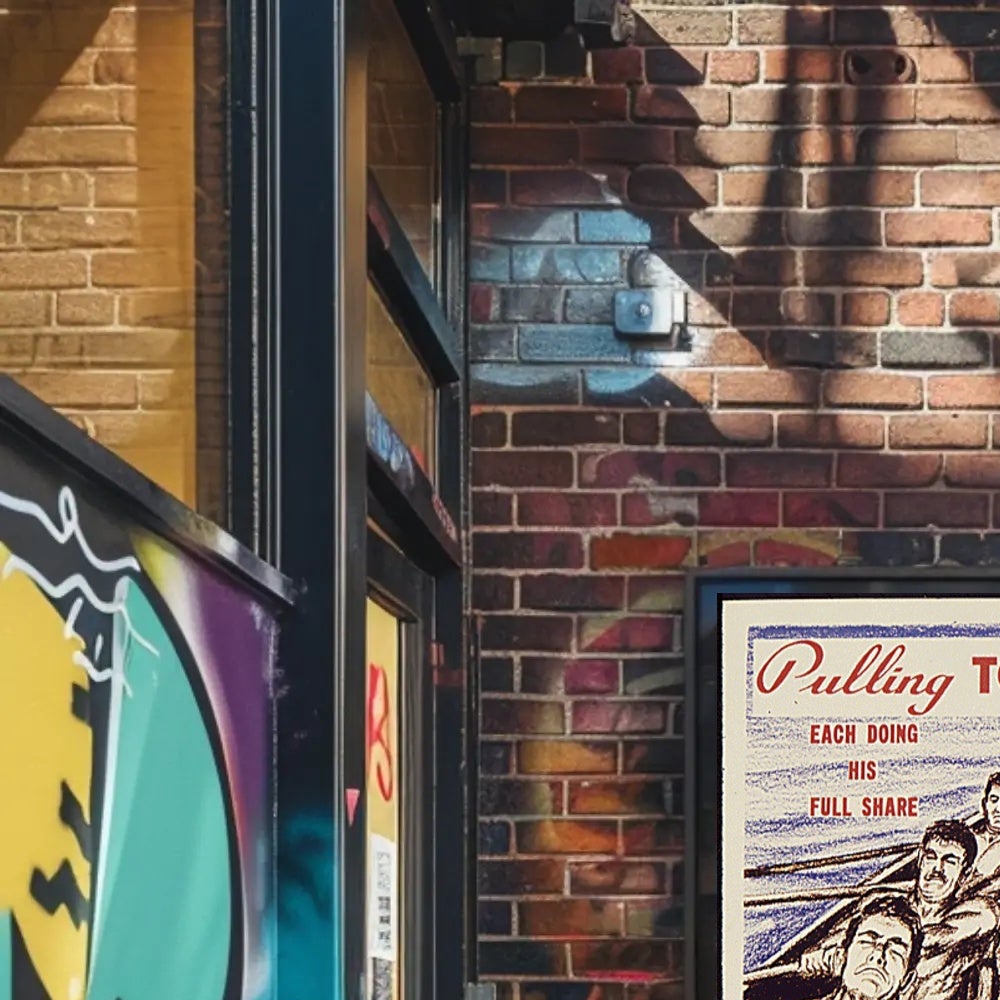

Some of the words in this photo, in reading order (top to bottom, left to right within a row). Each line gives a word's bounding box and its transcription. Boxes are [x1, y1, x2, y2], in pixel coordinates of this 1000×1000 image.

[757, 640, 954, 715] Pulling
[810, 725, 856, 744] EACH
[867, 724, 919, 744] DOING
[848, 761, 877, 781] HIS
[810, 798, 852, 817] FULL
[862, 797, 918, 817] SHARE
